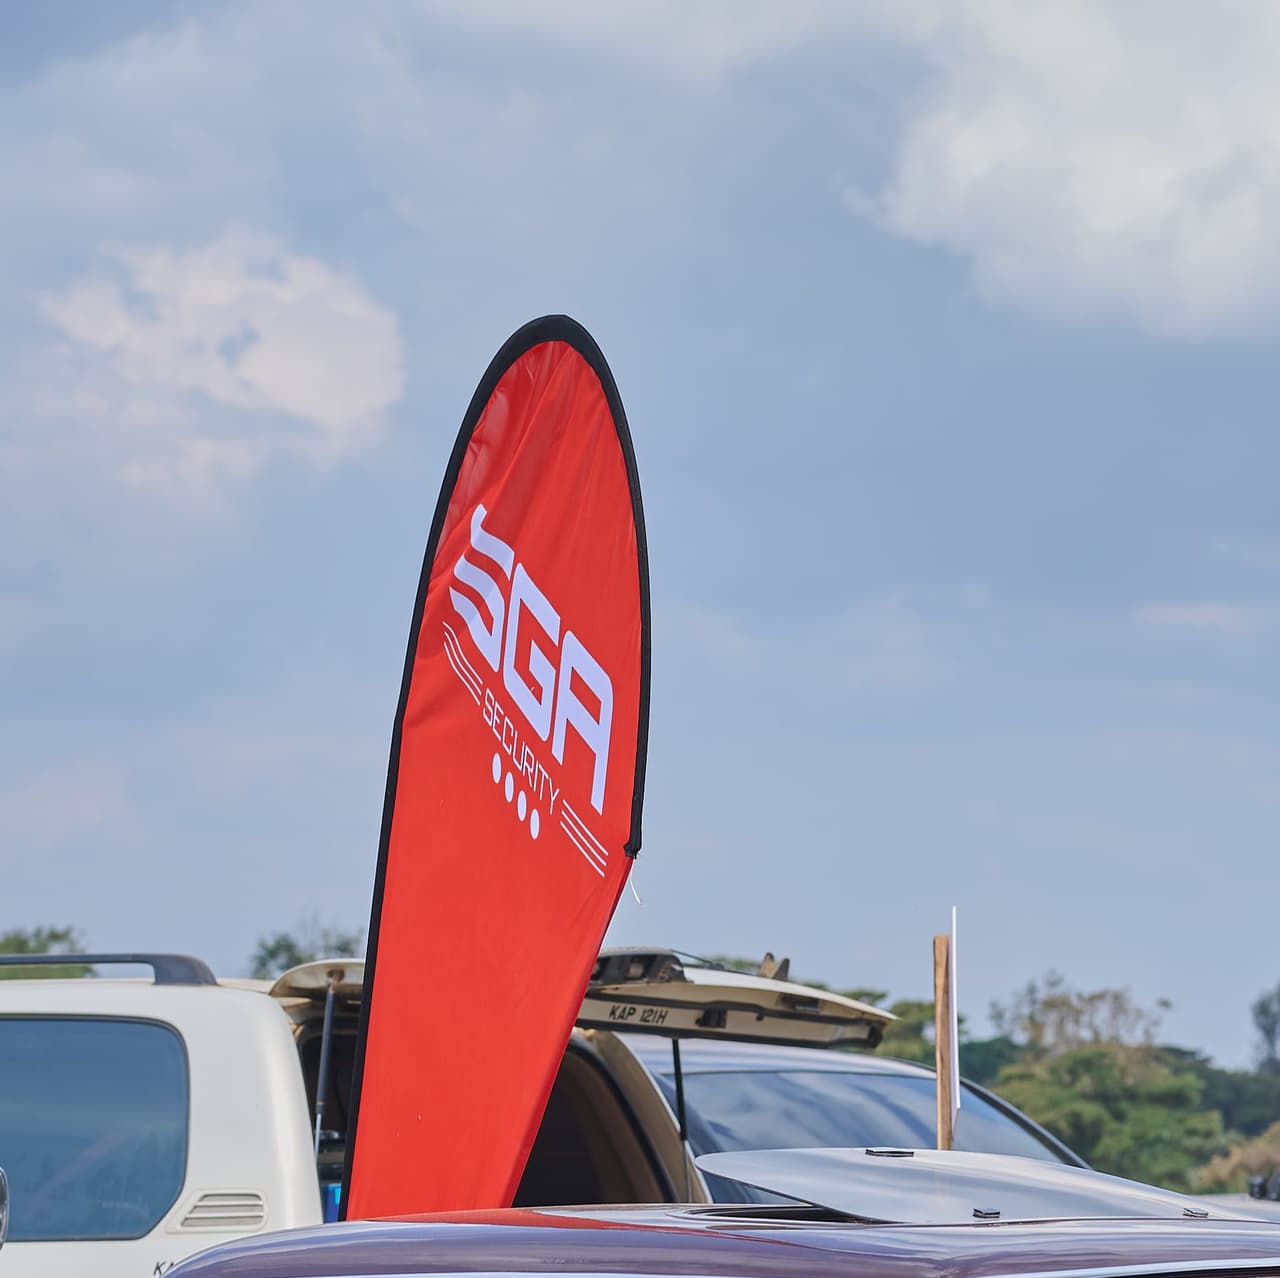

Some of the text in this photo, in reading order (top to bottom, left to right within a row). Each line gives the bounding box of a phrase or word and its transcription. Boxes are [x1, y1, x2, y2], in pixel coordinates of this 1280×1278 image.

[448, 503, 614, 816] SGA
[482, 687, 560, 815] SECURITY
[609, 1004, 637, 1021] KAP
